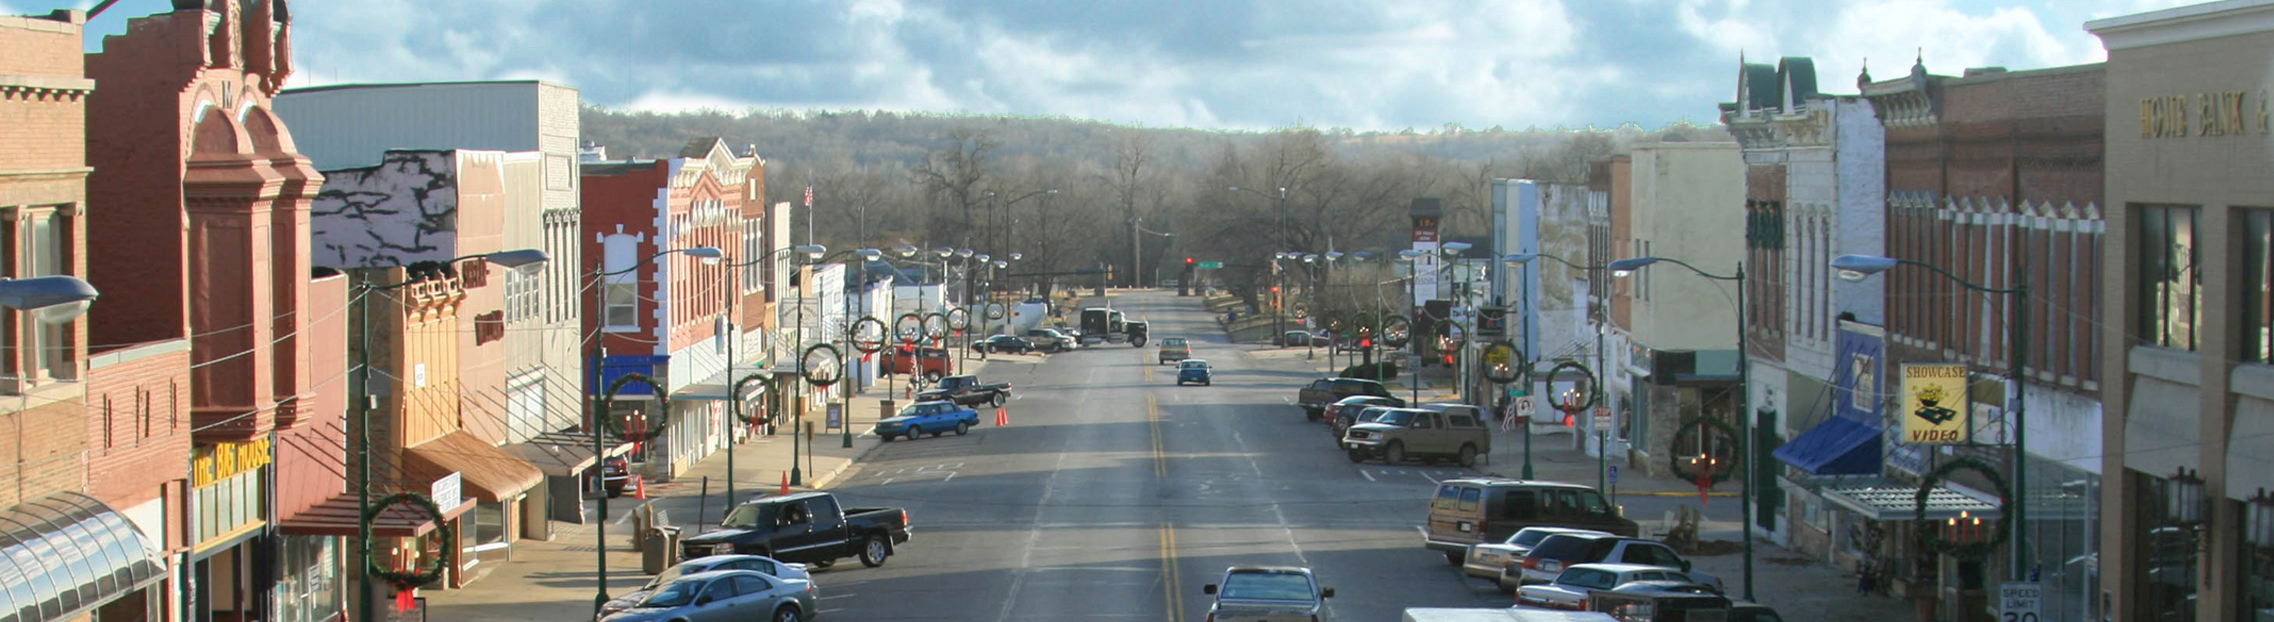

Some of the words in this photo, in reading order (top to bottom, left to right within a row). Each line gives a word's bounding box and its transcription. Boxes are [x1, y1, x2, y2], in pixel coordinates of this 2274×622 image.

[2141, 95, 2187, 138] HOME
[2198, 91, 2245, 136] BANK
[1906, 366, 1966, 379] SHOWCASE
[1913, 429, 1959, 442] VIDEO
[216, 442, 236, 480] BIG
[237, 436, 271, 473] HOUSE
[2003, 588, 2040, 598] SPEED
[2006, 600, 2035, 609] LIMIT
